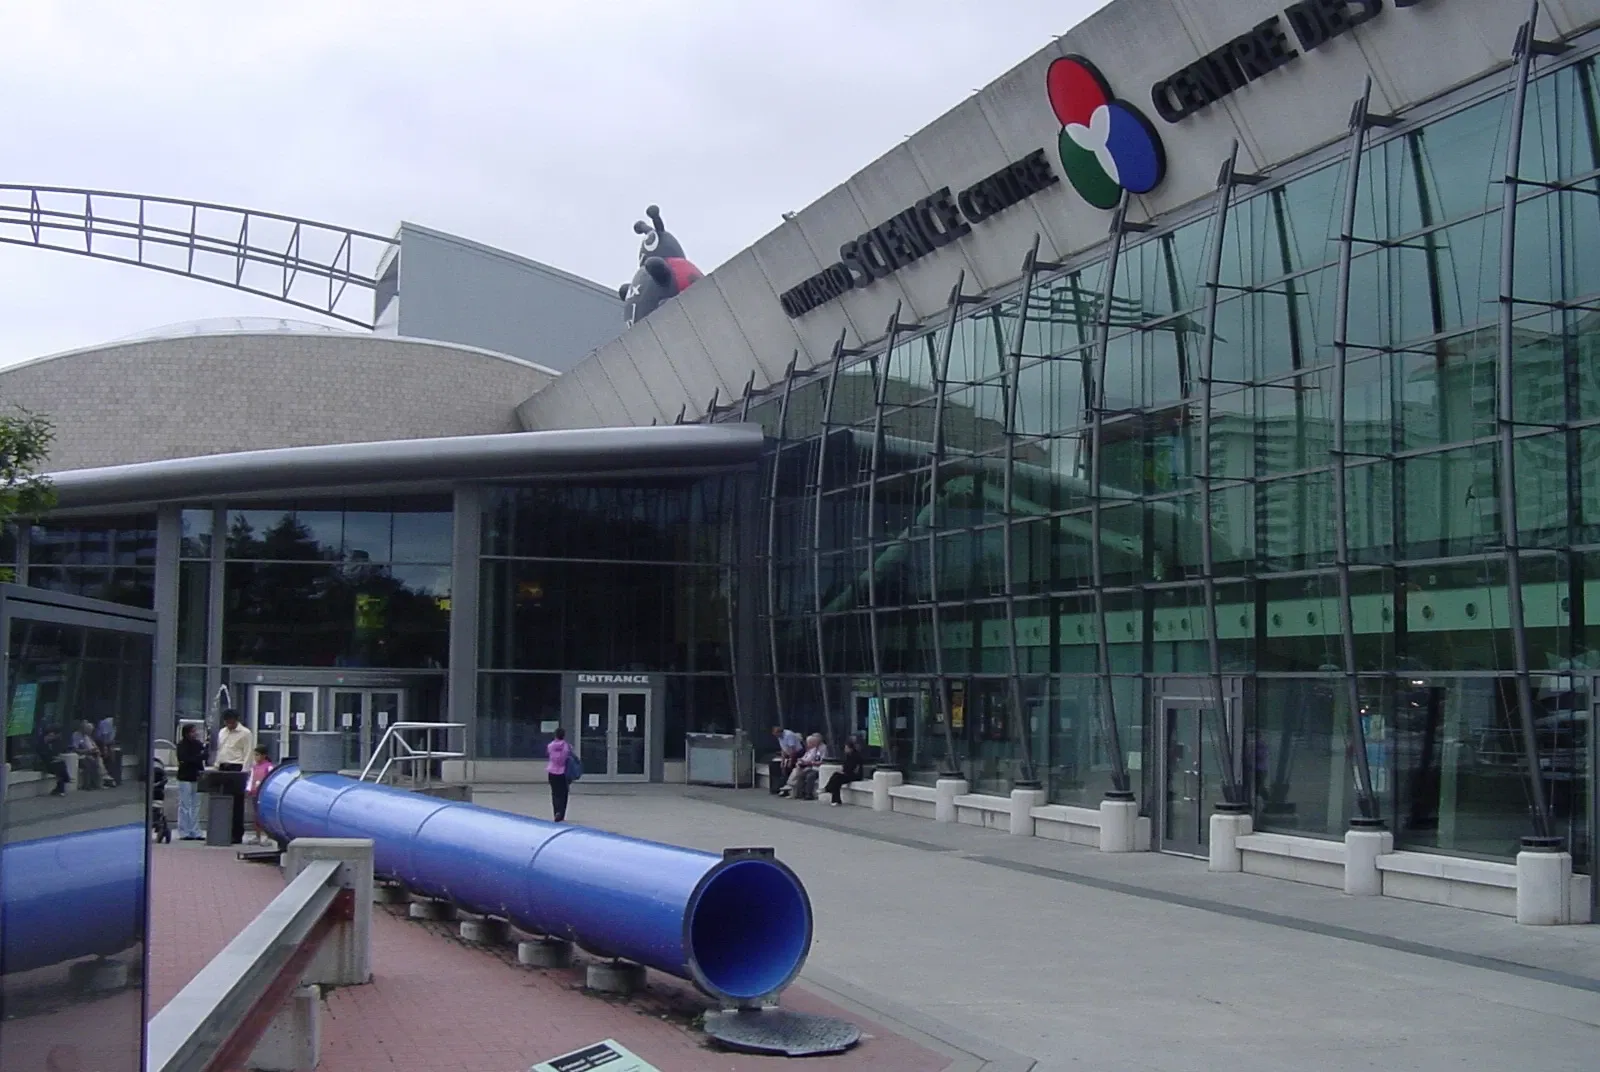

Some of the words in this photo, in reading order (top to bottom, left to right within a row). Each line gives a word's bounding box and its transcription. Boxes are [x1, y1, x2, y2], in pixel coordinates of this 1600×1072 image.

[1151, 14, 1299, 123] CENTRE
[780, 261, 855, 319] ONTARIO
[840, 186, 972, 289] SCIENCE
[957, 147, 1061, 225] CENTRE
[577, 674, 649, 684] ENTRANCE
